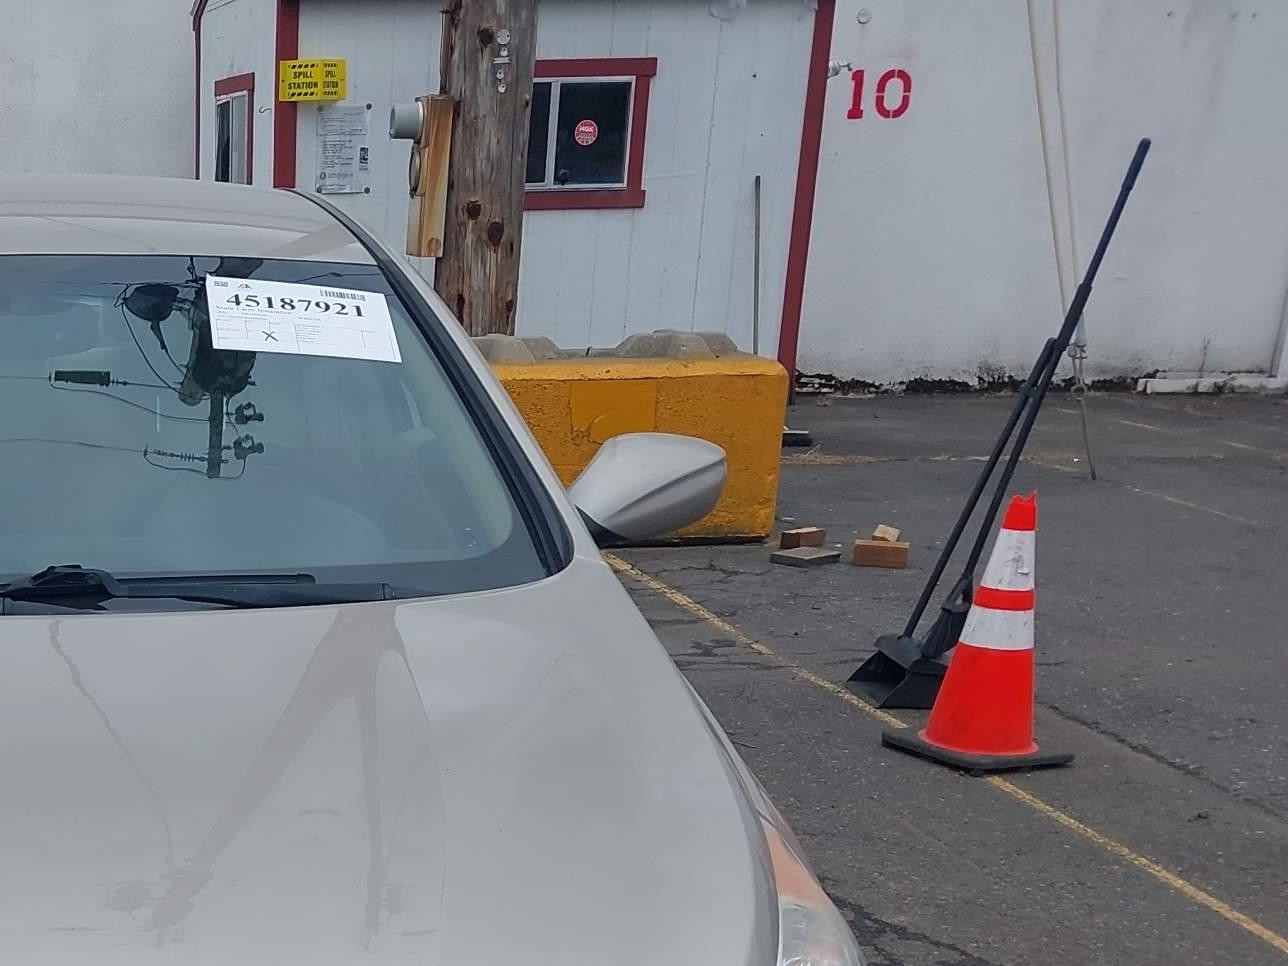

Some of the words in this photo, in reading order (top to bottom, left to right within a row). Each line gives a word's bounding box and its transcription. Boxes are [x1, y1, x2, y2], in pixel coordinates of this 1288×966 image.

[293, 71, 313, 79] SPILL
[287, 81, 319, 90] STATION
[847, 69, 912, 119] 10
[226, 293, 367, 317] 45187921
